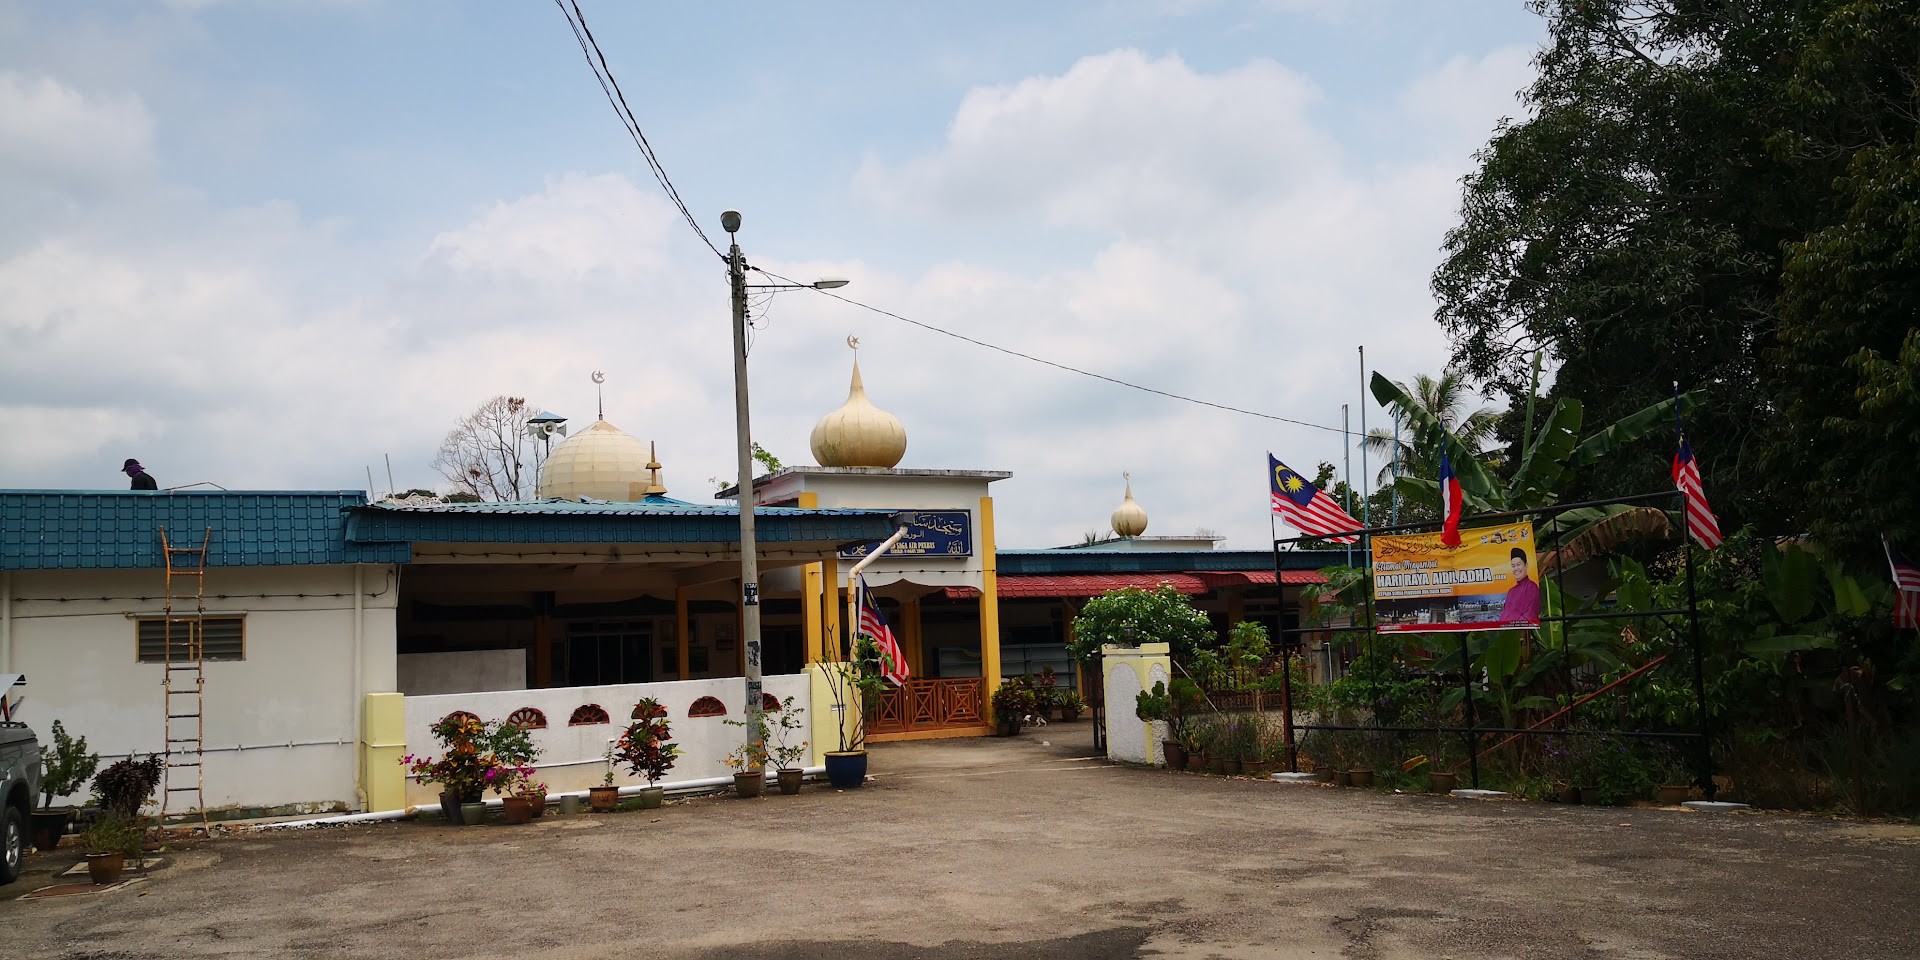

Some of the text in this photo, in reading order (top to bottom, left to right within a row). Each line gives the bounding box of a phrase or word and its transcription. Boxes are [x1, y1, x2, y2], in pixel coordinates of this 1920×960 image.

[1376, 574, 1403, 587] HARI
[1404, 573, 1430, 586] RAYA
[1432, 571, 1459, 585] AIDIL
[1459, 568, 1492, 583] ADHA
